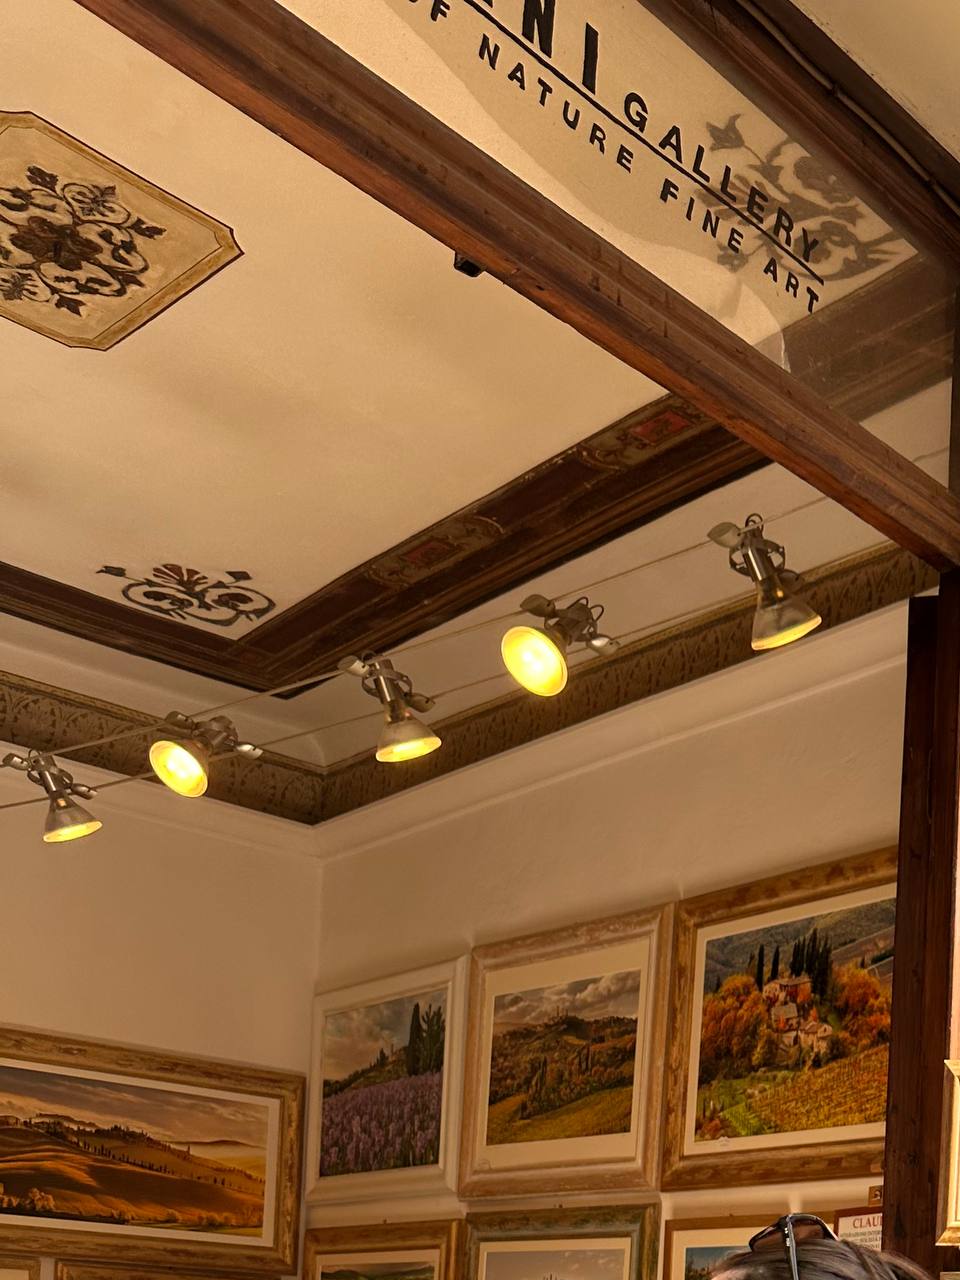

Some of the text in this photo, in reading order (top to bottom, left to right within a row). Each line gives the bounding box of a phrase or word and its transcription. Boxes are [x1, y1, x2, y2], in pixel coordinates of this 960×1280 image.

[408, 0, 819, 314] F NATURE FINE ART
[481, 0, 819, 262] NI GALLERY
[852, 1215, 883, 1229] CLAU
